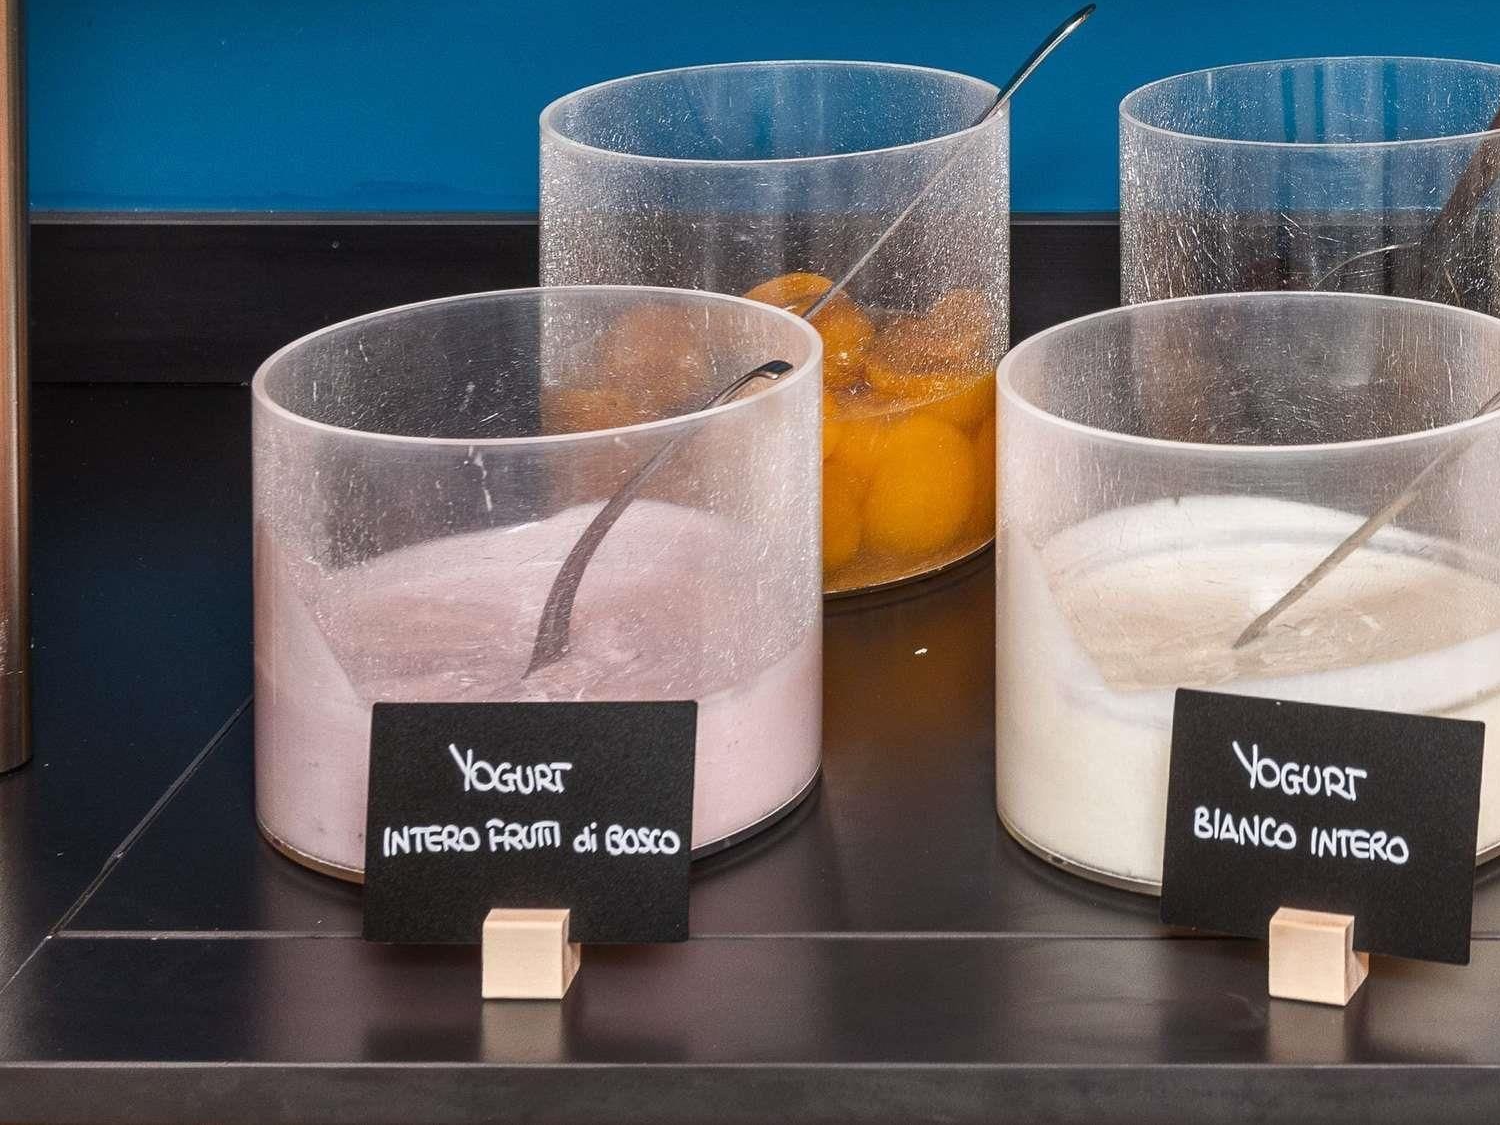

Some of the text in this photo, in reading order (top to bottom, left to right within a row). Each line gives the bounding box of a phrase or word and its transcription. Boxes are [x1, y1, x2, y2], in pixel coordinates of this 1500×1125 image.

[449, 744, 574, 796] YOGURT
[1232, 741, 1369, 803] YOGURT
[384, 825, 482, 859] INTERO
[573, 822, 599, 854] di
[605, 825, 682, 857] BOSCO
[1194, 806, 1411, 866] BIANCO INTERO
